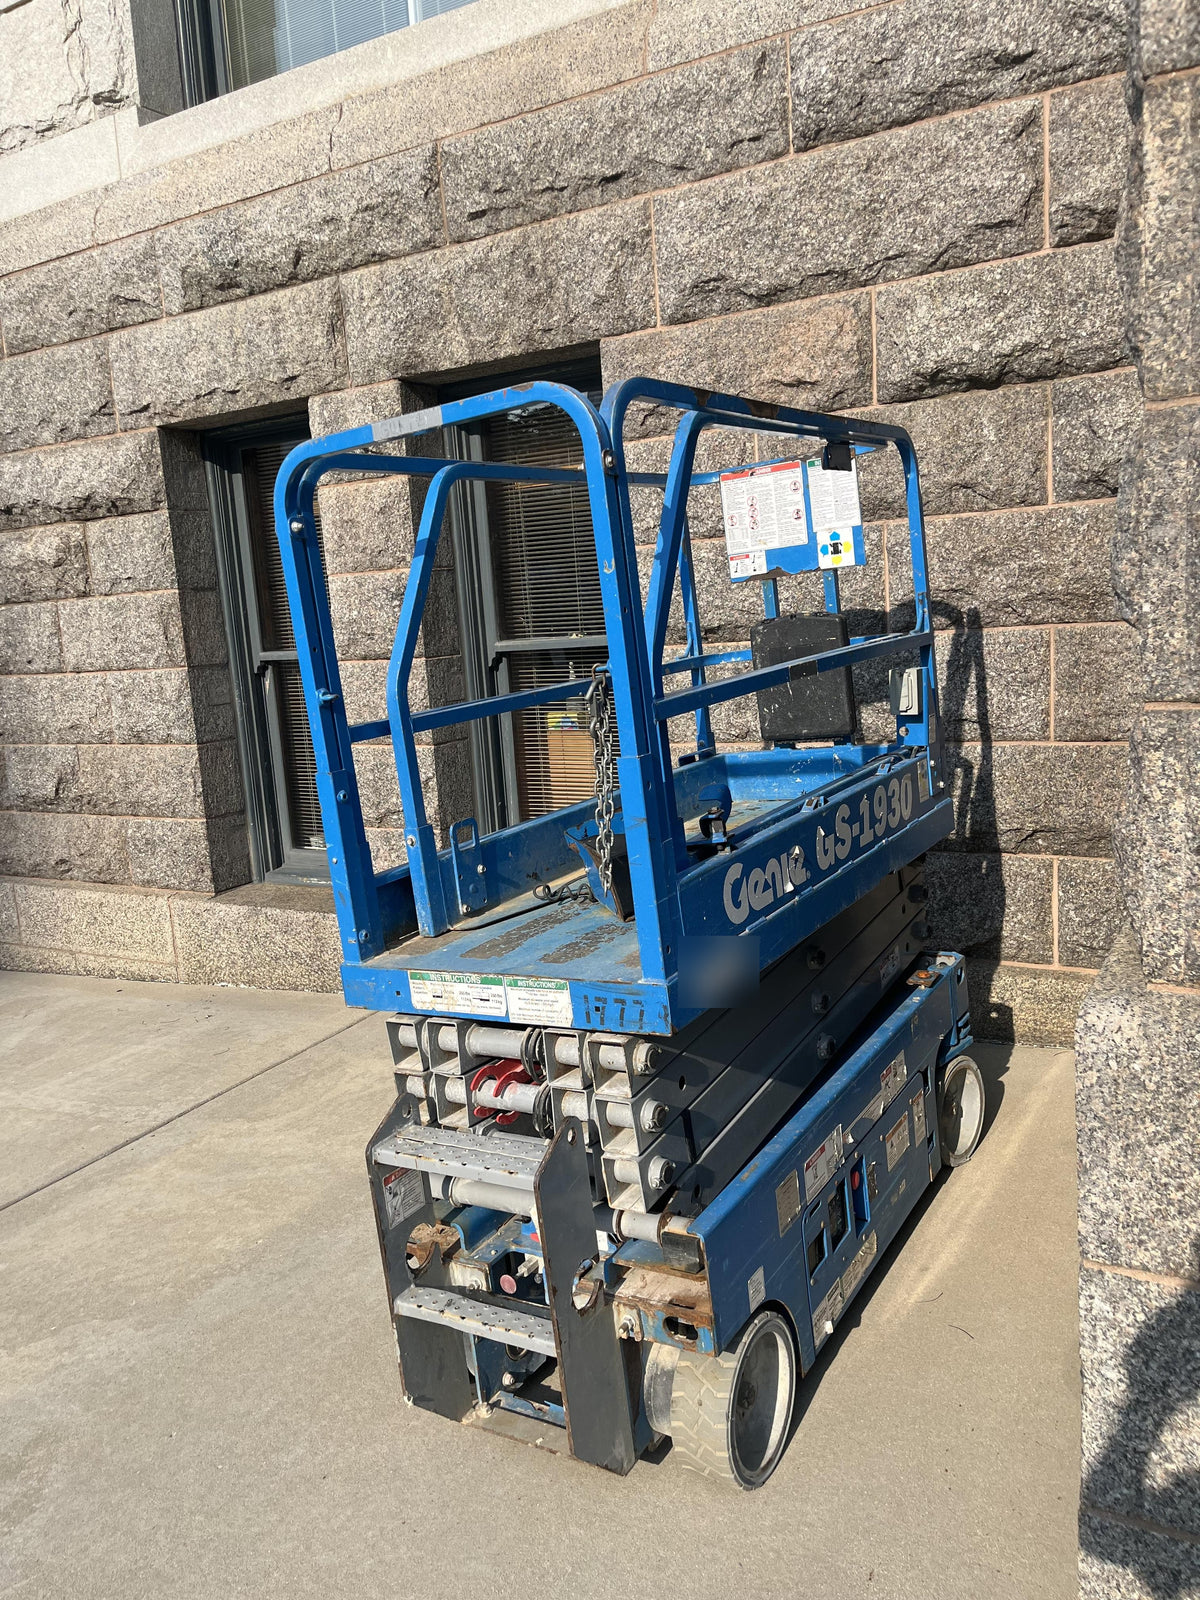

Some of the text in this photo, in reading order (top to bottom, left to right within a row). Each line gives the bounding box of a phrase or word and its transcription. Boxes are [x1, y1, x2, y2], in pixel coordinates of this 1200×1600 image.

[723, 773, 913, 924] Genie GS-1930
[429, 973, 481, 984] INSTRUCTIONS
[517, 979, 556, 989] INSTRUCTIONS
